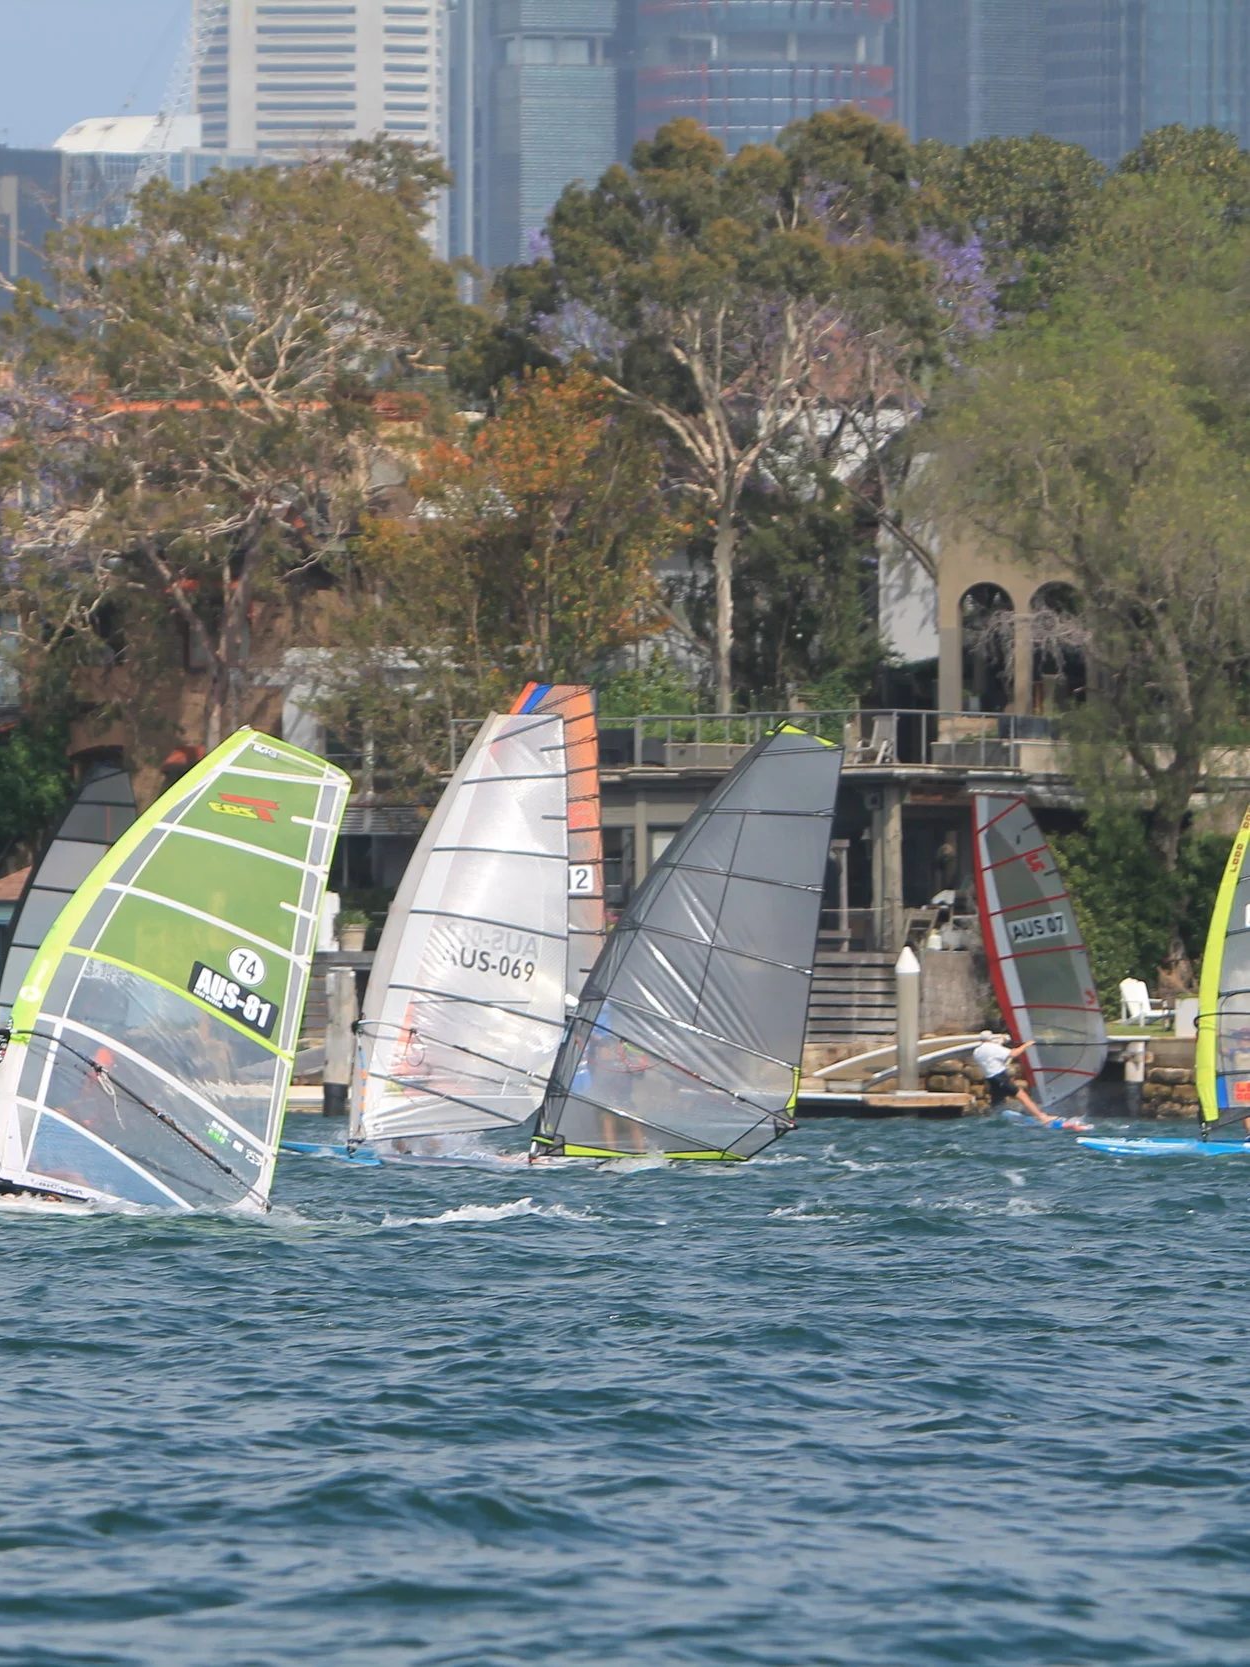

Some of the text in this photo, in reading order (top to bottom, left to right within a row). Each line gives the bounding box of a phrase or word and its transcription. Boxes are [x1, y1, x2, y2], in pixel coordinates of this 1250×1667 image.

[1013, 919, 1045, 940] AUS
[237, 953, 257, 980] 74
[193, 967, 271, 1028] AUS-81
